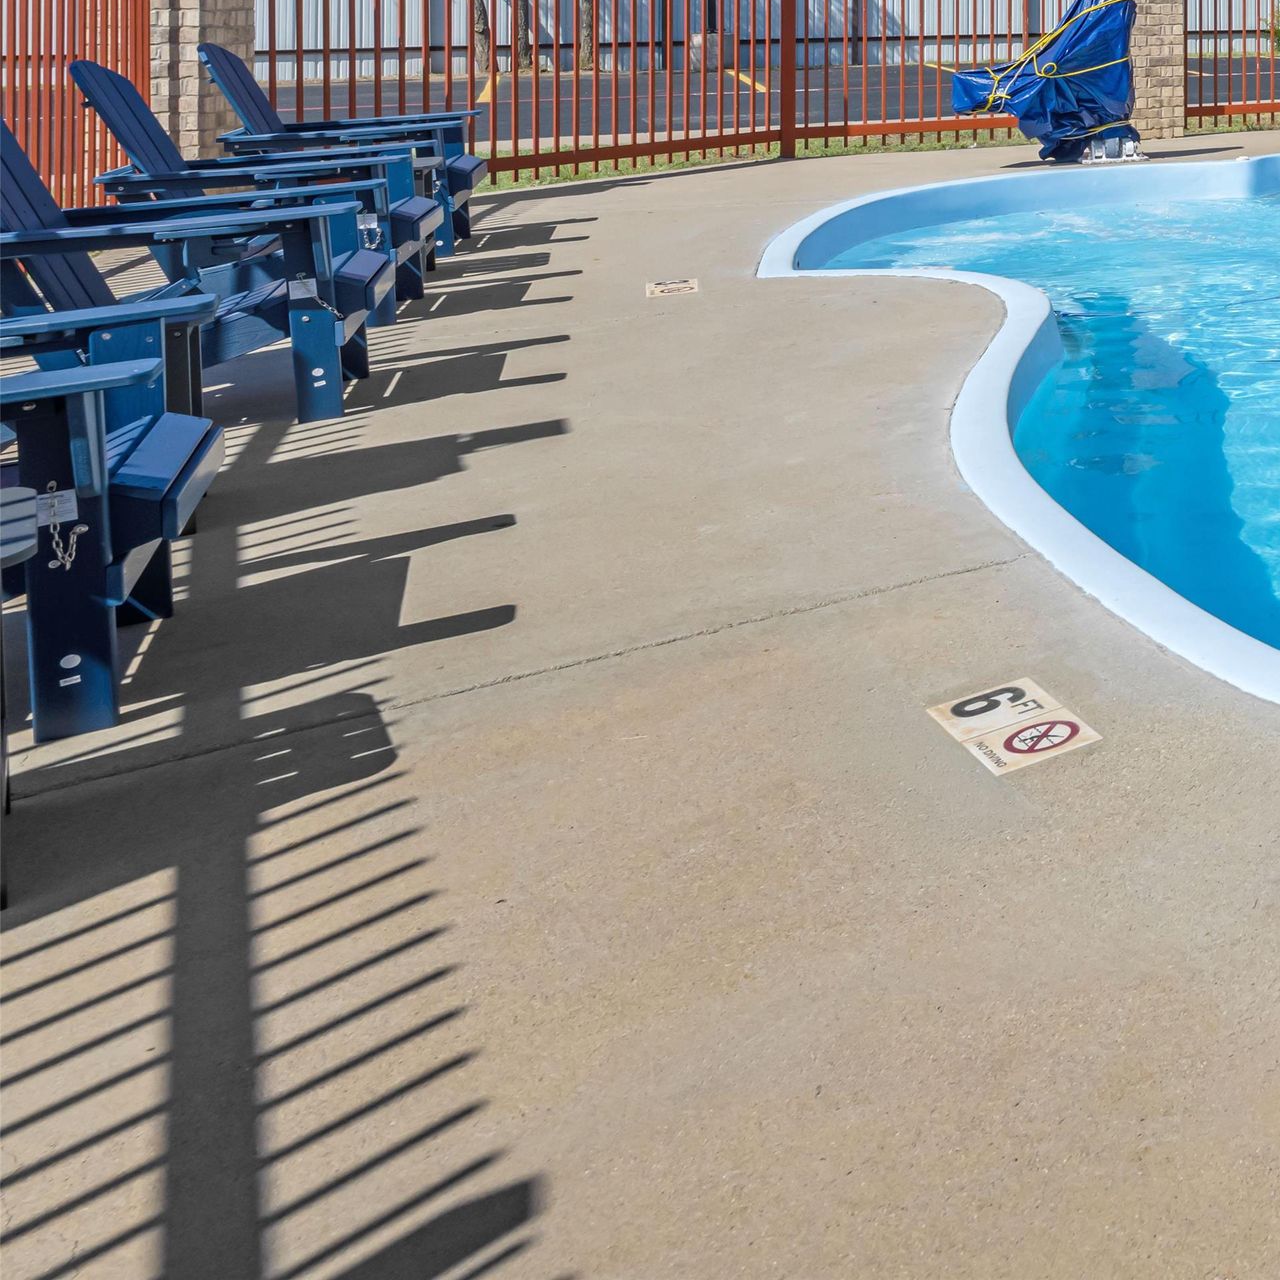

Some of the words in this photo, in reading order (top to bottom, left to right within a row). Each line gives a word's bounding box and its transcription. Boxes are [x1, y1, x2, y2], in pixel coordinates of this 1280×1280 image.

[950, 686, 1027, 718] 6
[1009, 698, 1045, 715] FT
[974, 741, 989, 751] NO
[983, 749, 1008, 768] DIVING
